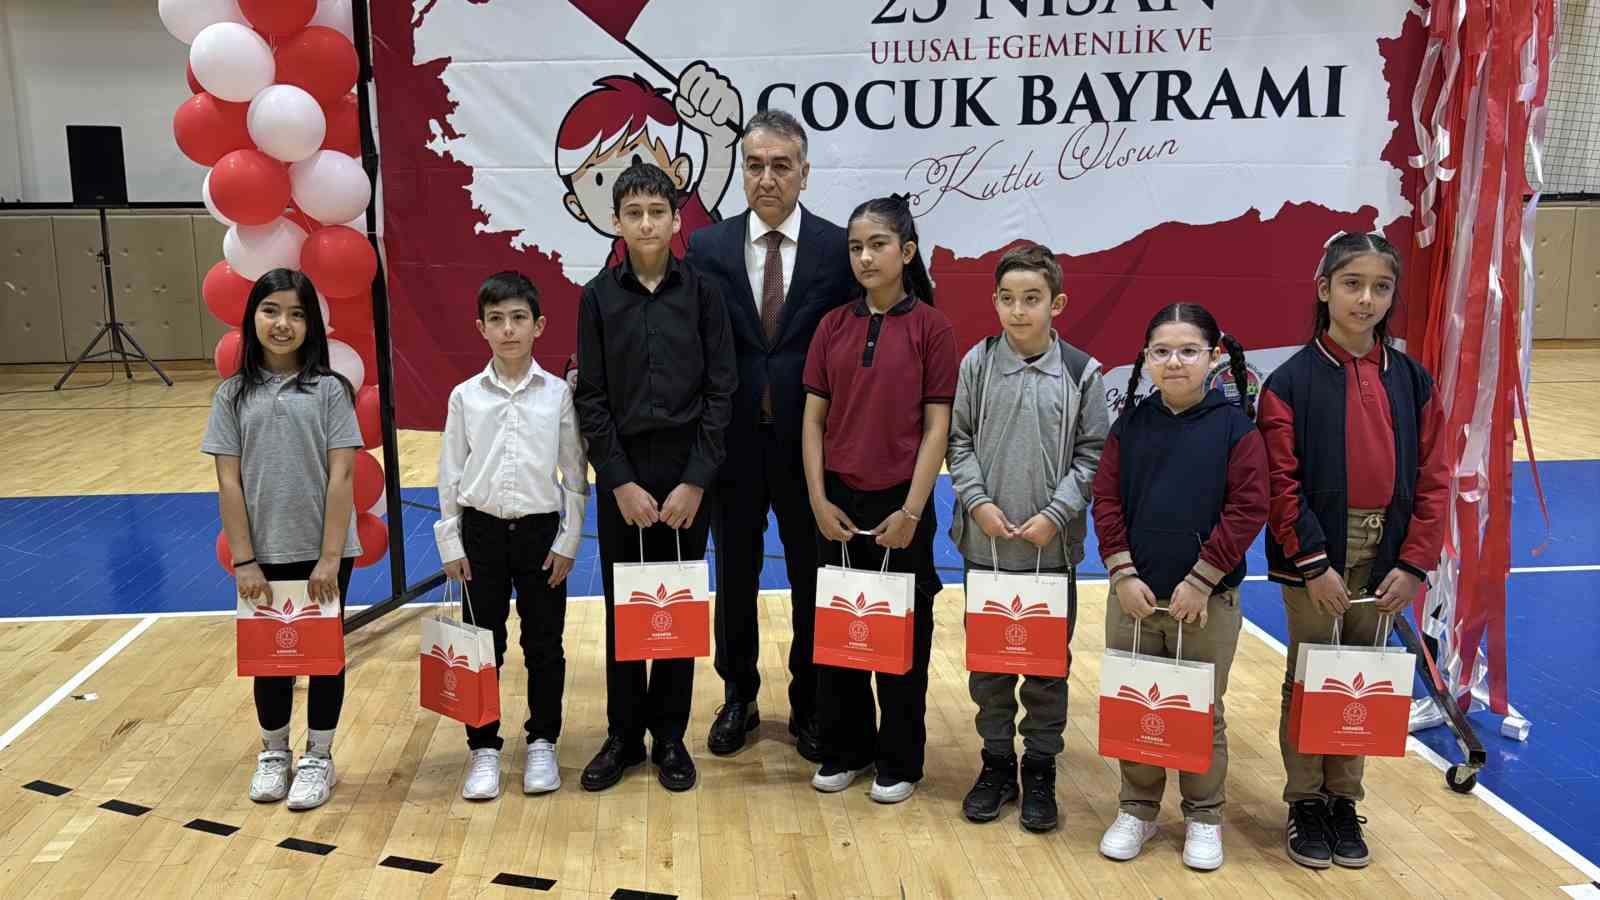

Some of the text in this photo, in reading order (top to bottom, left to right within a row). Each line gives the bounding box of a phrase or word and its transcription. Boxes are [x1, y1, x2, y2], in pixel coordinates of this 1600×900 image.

[870, 25, 1213, 65] ULUSAL EGEMENLİK VE
[1017, 64, 1350, 126] BAYRAMI
[904, 120, 1180, 219] Kutlu Olsun
